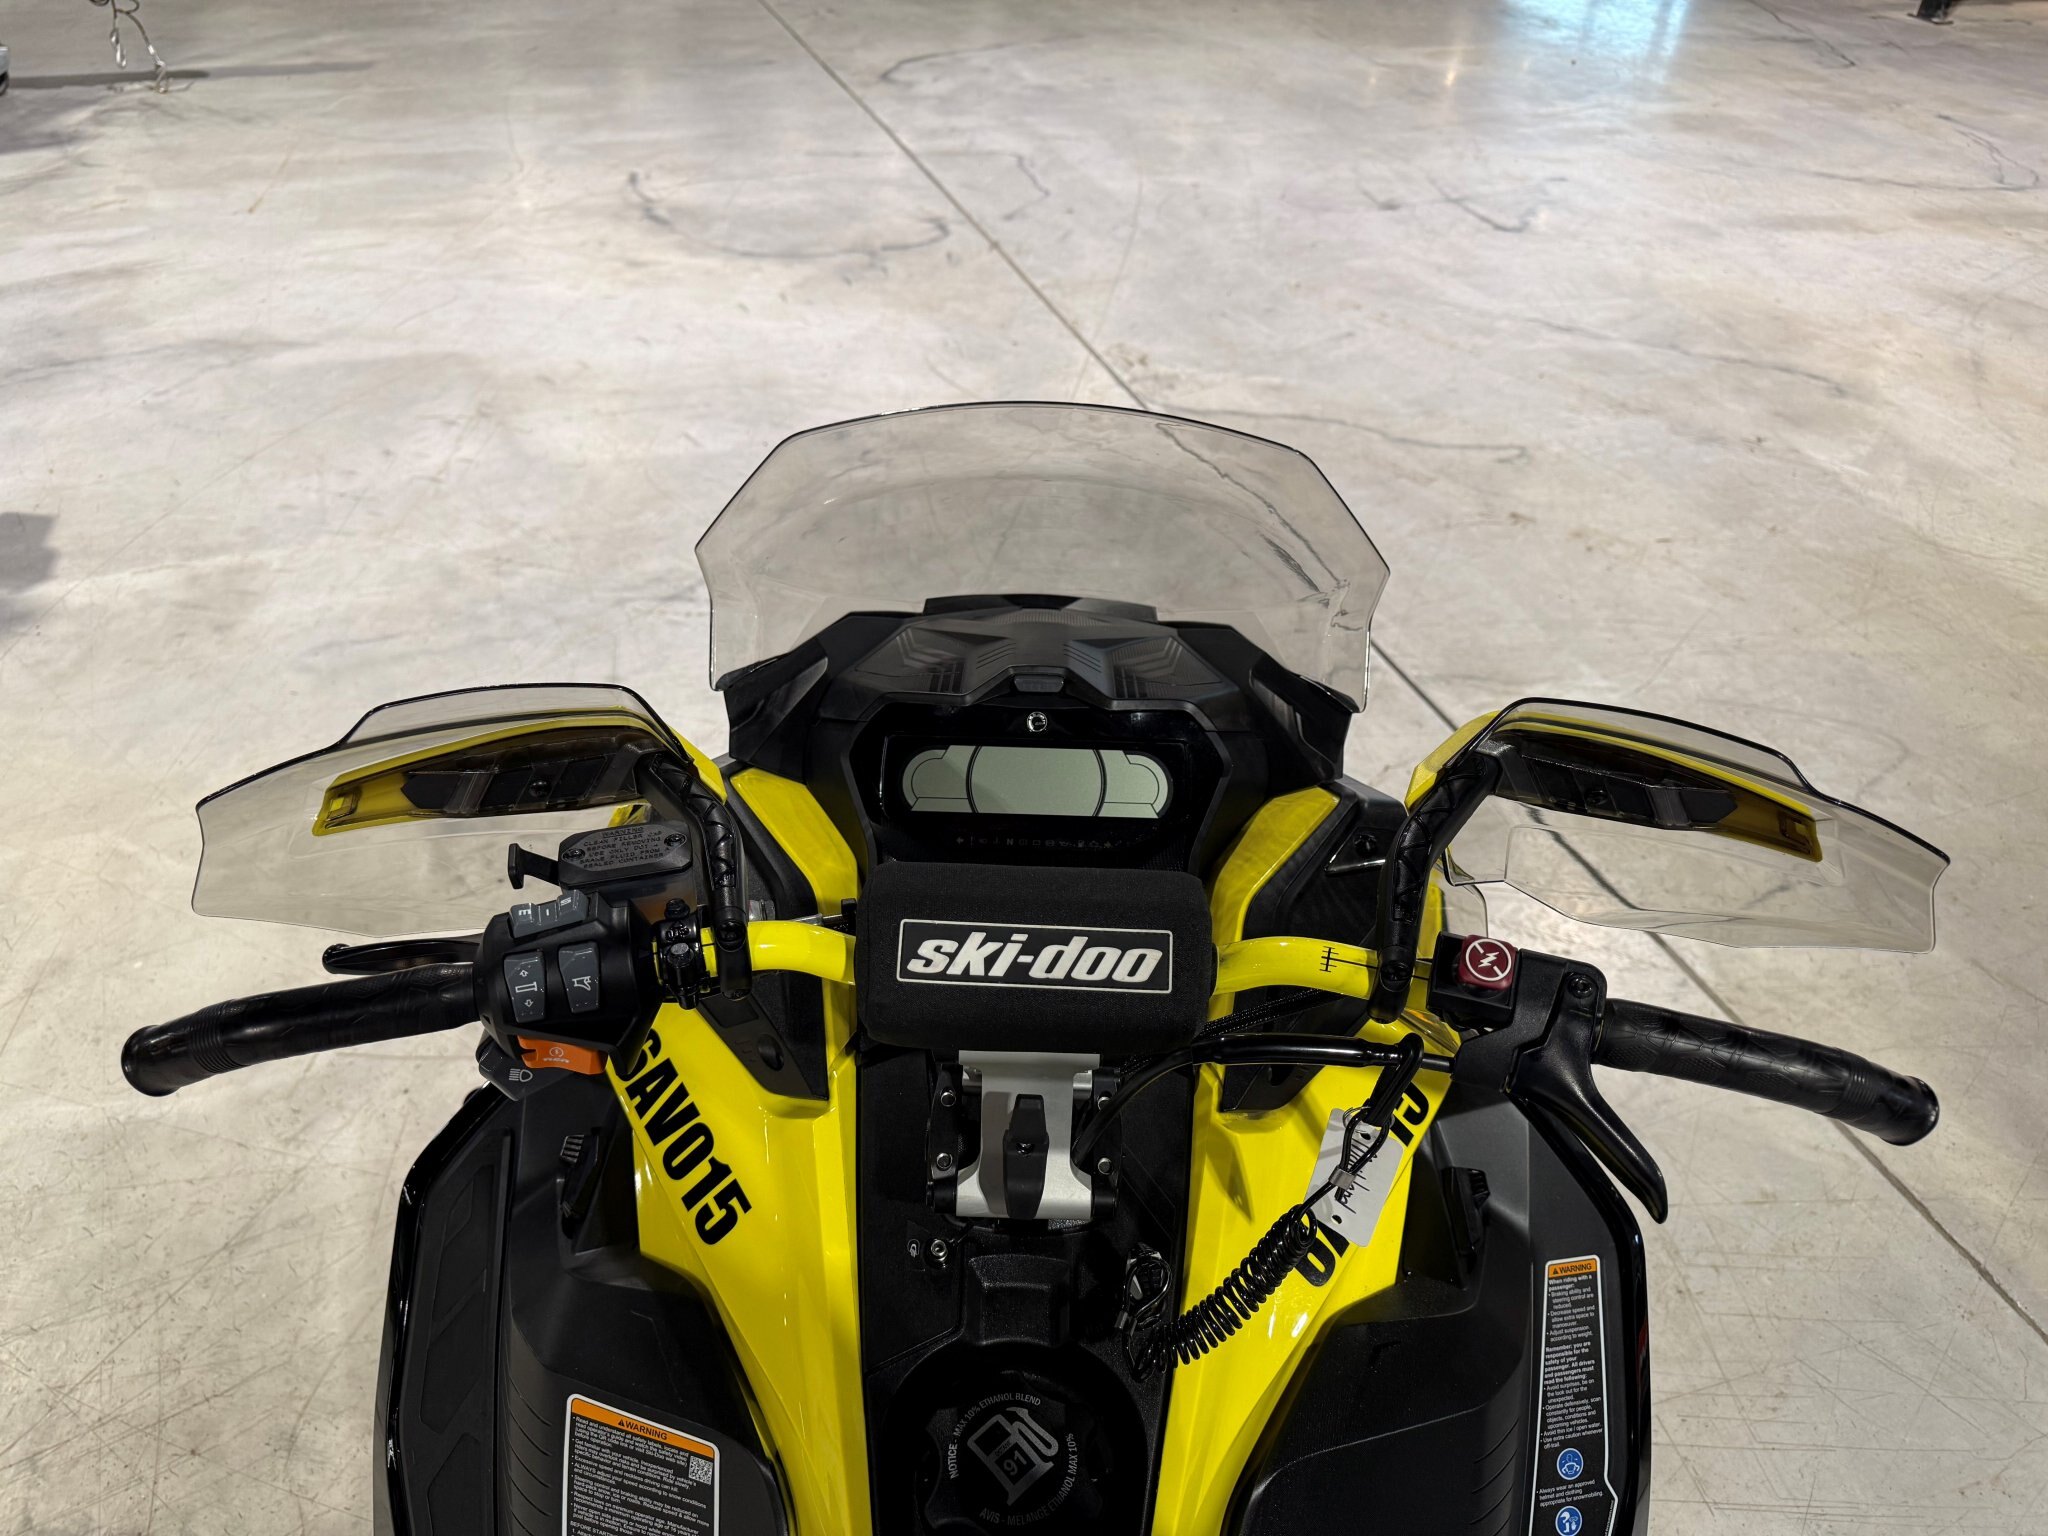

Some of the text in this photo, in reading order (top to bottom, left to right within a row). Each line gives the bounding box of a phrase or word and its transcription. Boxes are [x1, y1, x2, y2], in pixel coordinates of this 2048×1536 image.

[602, 827, 644, 837] WARNING
[587, 844, 616, 852] BEFORE
[907, 932, 1162, 983] ski-doo
[1560, 1264, 1592, 1273] WARNING
[978, 1392, 1015, 1409] ETHANOL
[1015, 1392, 1041, 1407] BLEND
[625, 1422, 668, 1441] WARNING
[953, 1419, 968, 1438] MAX
[947, 1442, 960, 1480] NOTICE
[978, 1506, 1001, 1525] AVIS
[1047, 1476, 1076, 1511] ETHANOL
[1067, 1454, 1079, 1475] MAX
